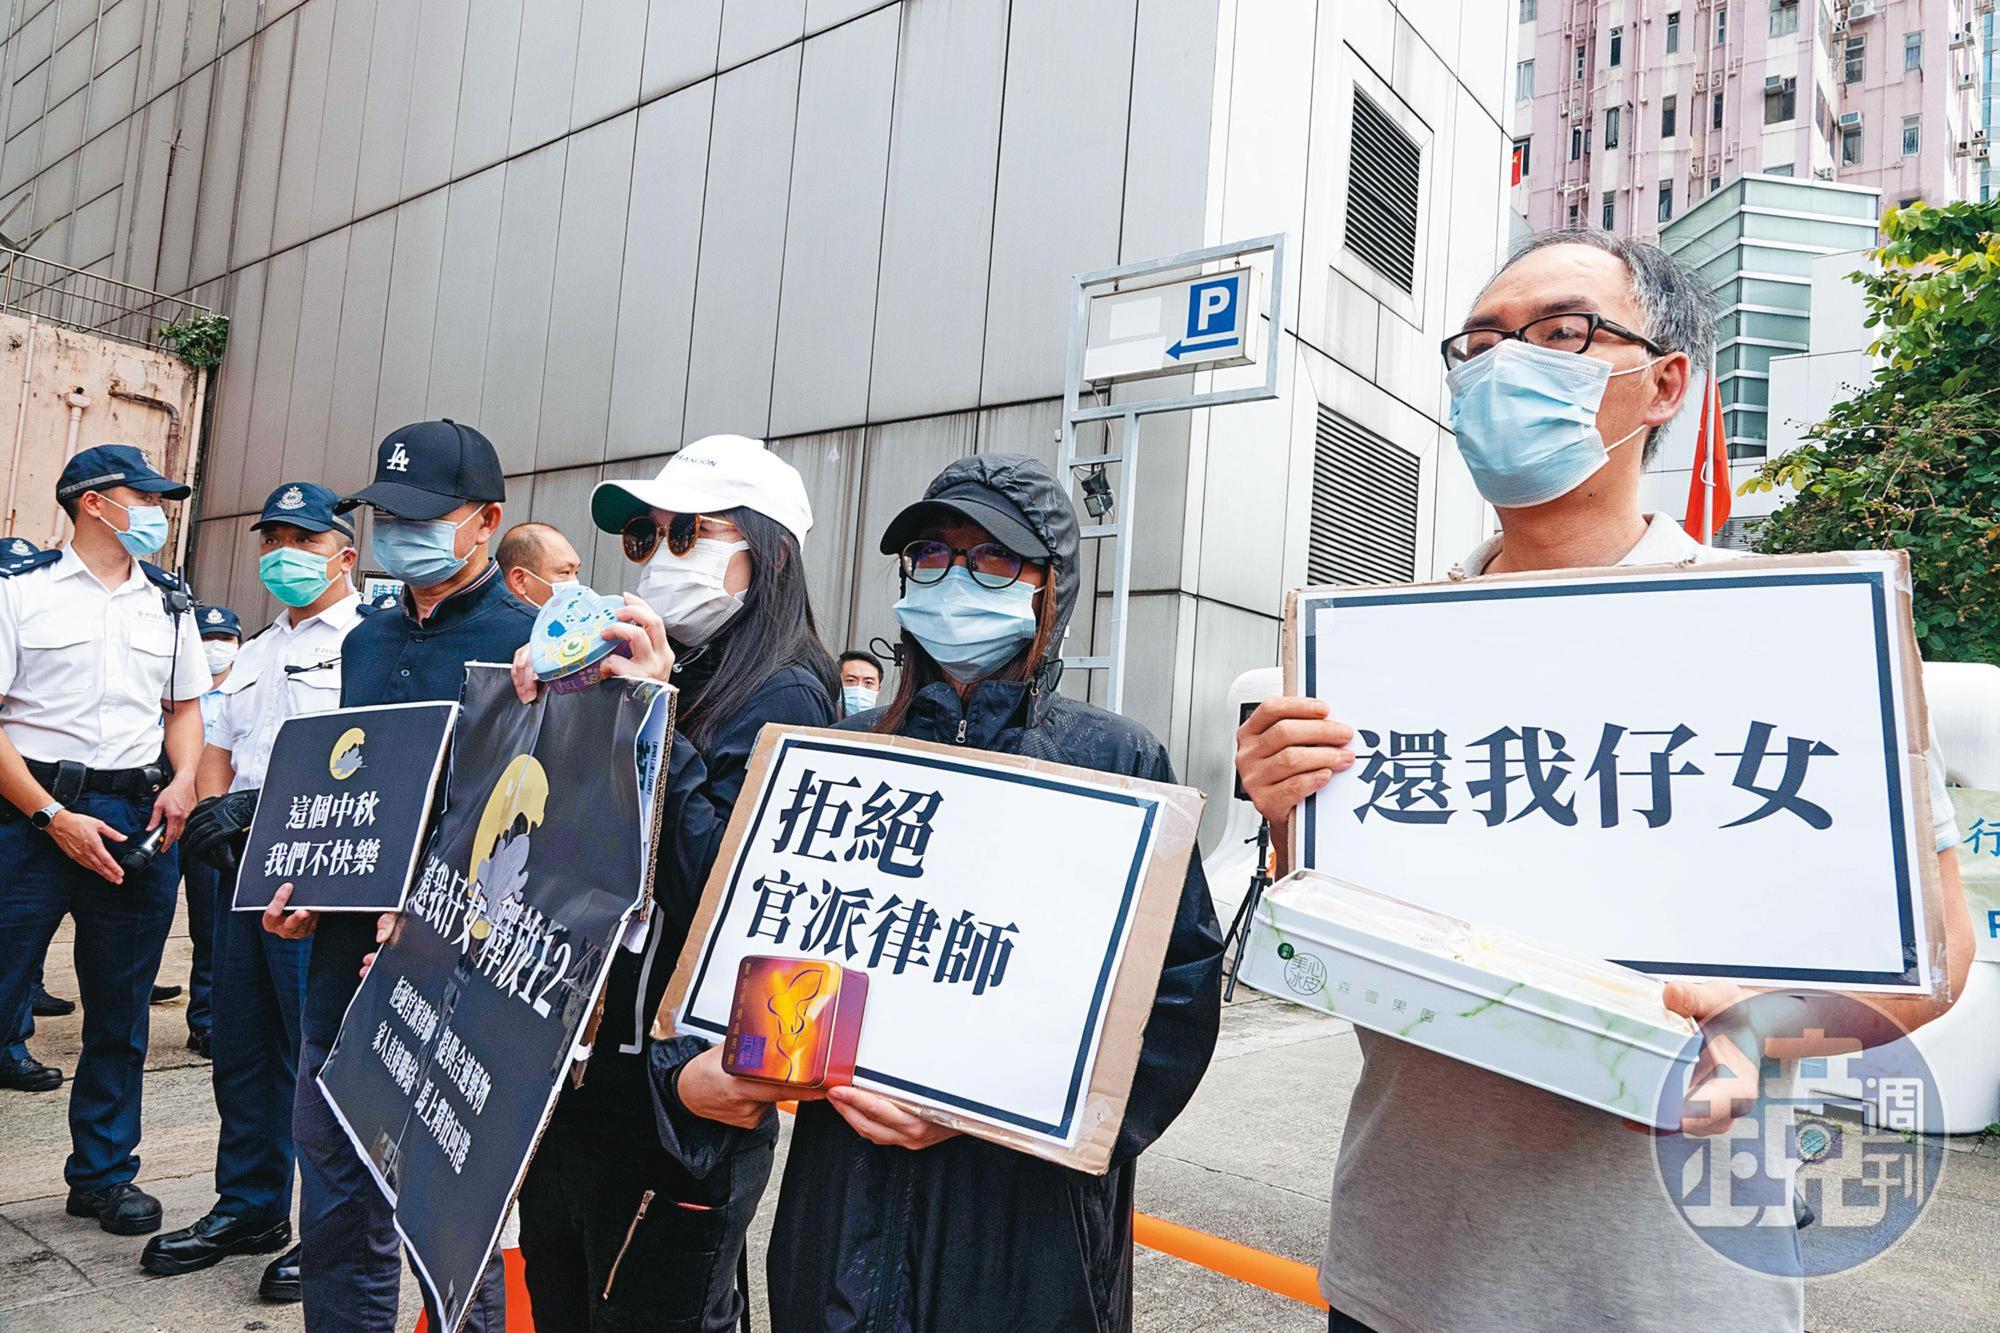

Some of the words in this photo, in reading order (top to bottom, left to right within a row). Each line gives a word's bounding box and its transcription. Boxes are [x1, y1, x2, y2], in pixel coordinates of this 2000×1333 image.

[1197, 286, 1231, 331] P
[386, 442, 410, 472] LA
[285, 790, 381, 830] 這個中秋
[1353, 719, 1840, 831] 還我仔女
[264, 838, 381, 878] 我們不快樂
[771, 768, 945, 879] 拒絕
[406, 855, 488, 955] 還我仔女
[745, 869, 1021, 996] 官派律師
